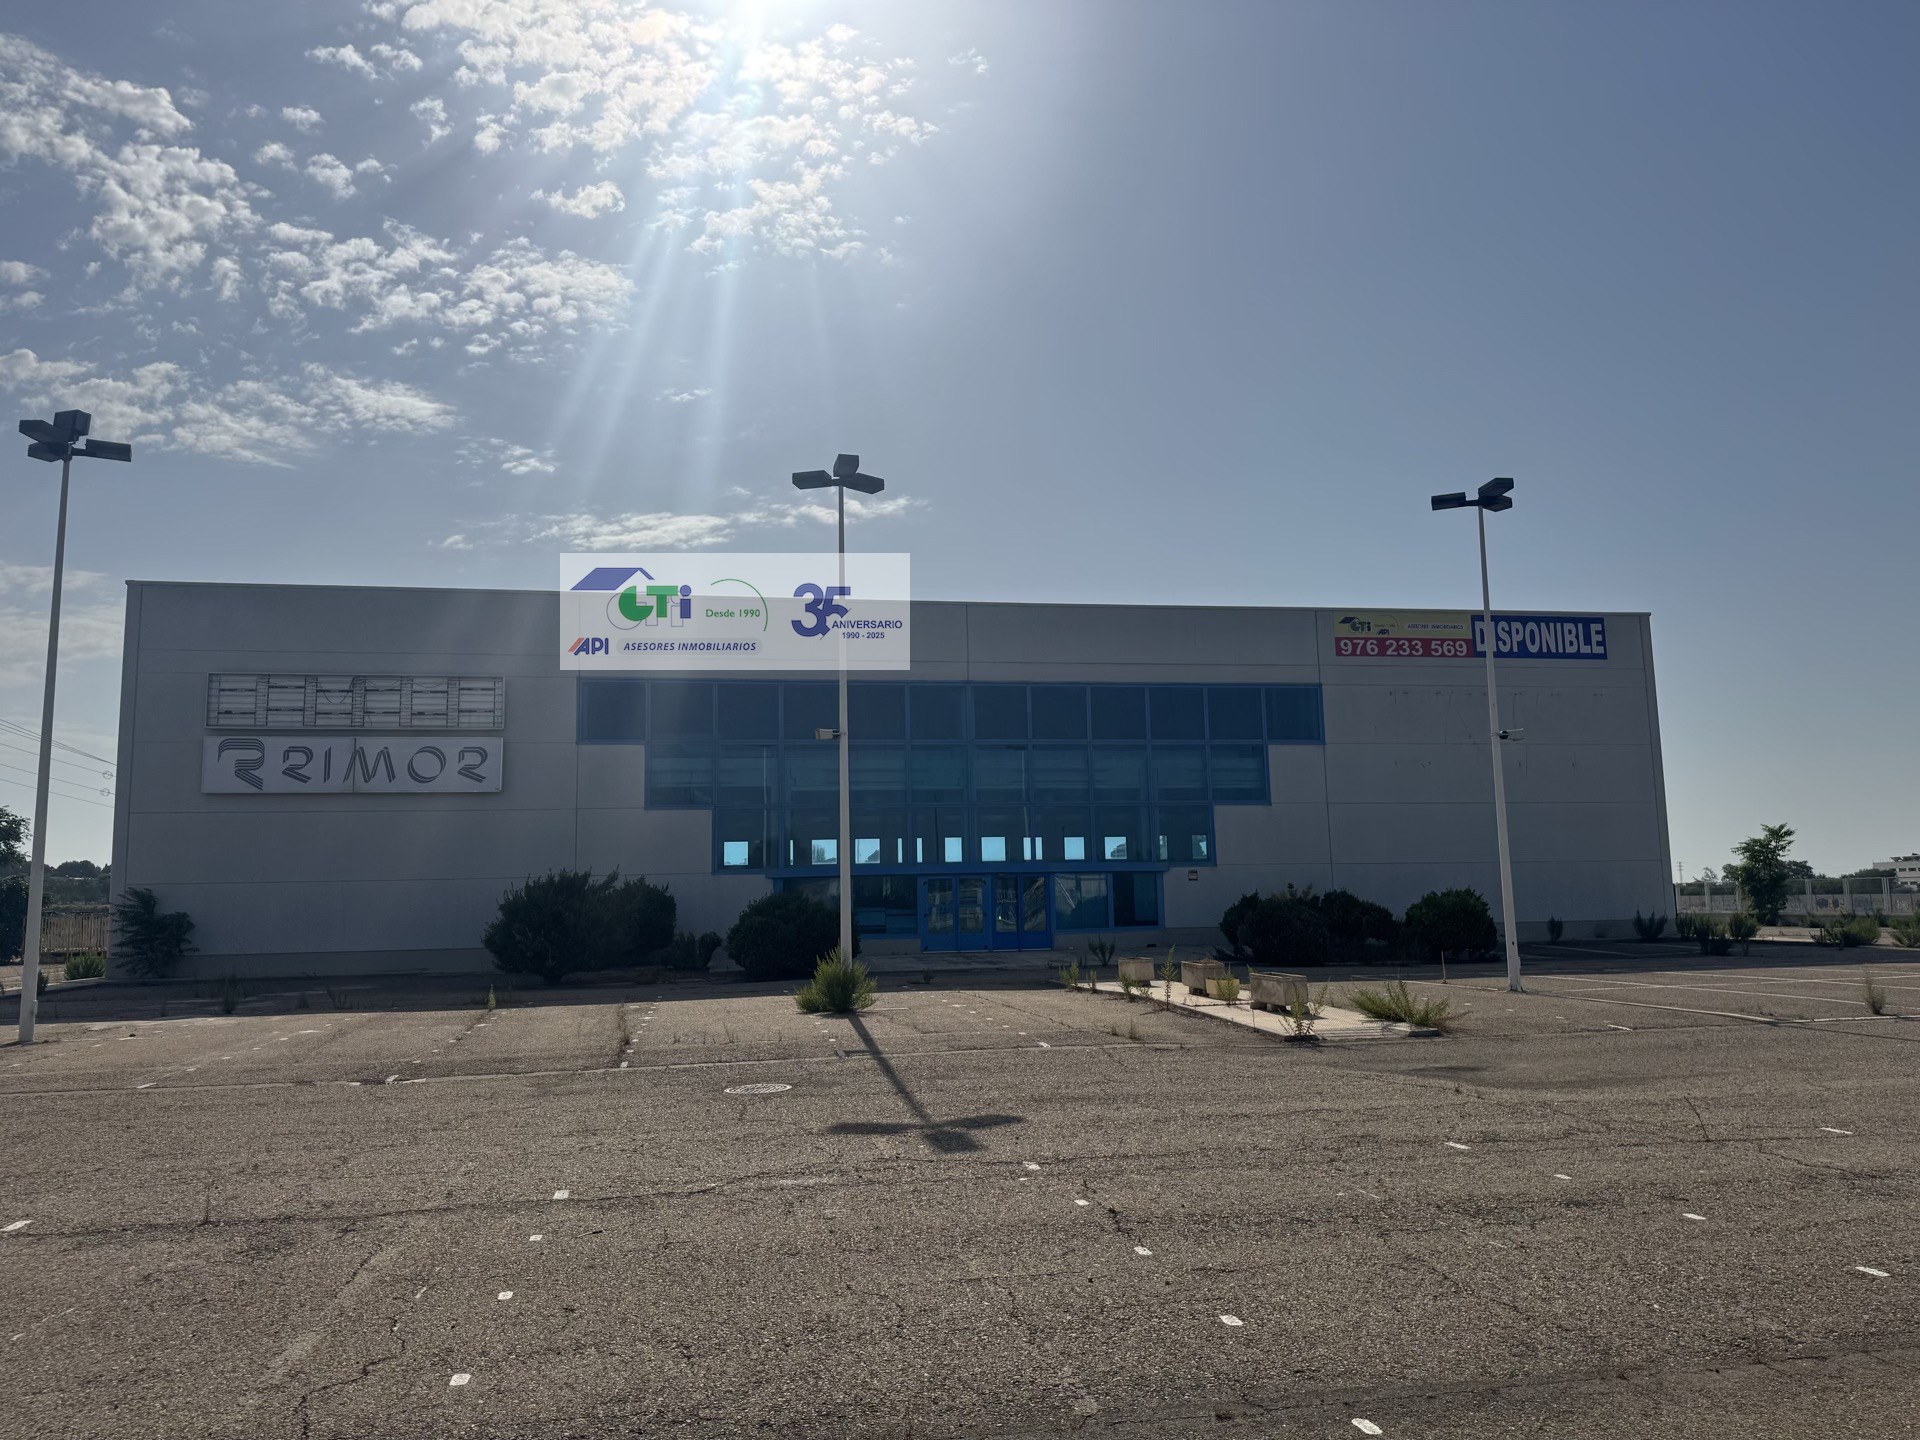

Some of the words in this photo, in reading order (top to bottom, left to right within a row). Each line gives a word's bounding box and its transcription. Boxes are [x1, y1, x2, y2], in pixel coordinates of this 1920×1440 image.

[1340, 639, 1379, 655] 976
[1385, 639, 1424, 655] 233
[1430, 640, 1468, 656] 569
[1474, 620, 1605, 654] DISPONIBLE
